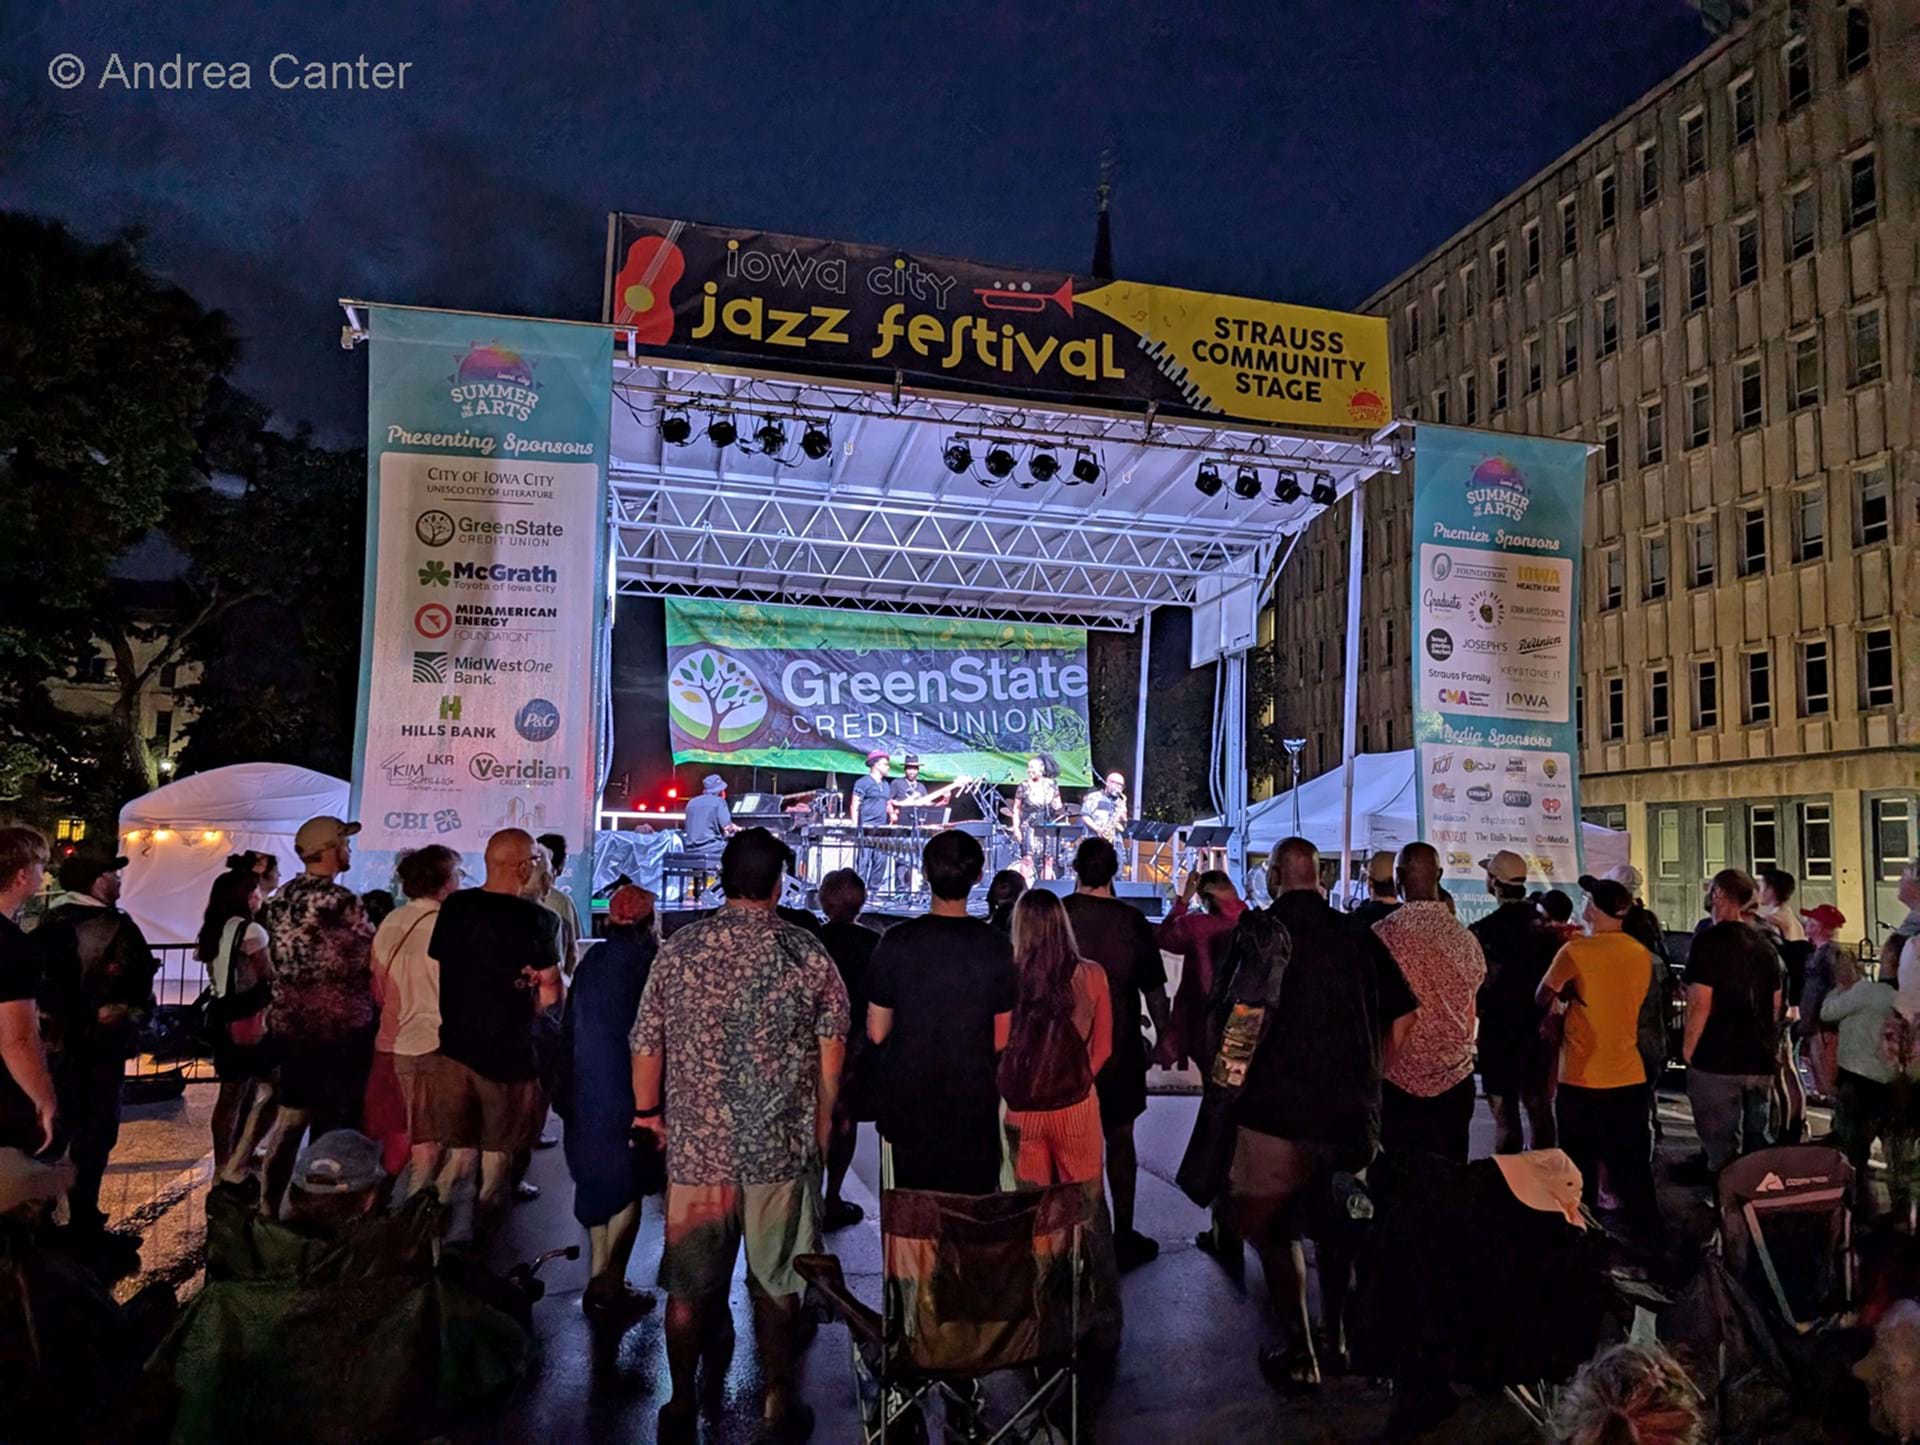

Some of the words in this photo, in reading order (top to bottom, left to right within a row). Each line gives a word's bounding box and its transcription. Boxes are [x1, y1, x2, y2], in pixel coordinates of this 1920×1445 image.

[726, 240, 847, 294] iowa
[867, 259, 957, 310] city
[691, 281, 850, 347] jazz
[872, 303, 1126, 381] festival
[1215, 316, 1344, 354] STRAUSS
[1192, 340, 1366, 382] COMMUNITY
[450, 384, 539, 408] SUMMER
[1235, 372, 1323, 403] STAGE
[475, 400, 531, 421] ARTS
[387, 424, 496, 455] Presenting
[503, 432, 593, 456] Sponsors
[427, 467, 459, 482] CITY
[462, 471, 480, 483] OF
[523, 472, 554, 487] CITY
[427, 485, 465, 495] UNESCO
[466, 487, 487, 496] CITY
[488, 488, 500, 496] OF
[502, 489, 553, 499] LITERATURE
[1466, 488, 1530, 511] SUMMER
[1483, 502, 1524, 522] ARTS
[458, 516, 563, 536] GreenState
[458, 534, 504, 545] CREDIT
[509, 536, 550, 547] UNION
[1433, 522, 1491, 543] Premier
[1495, 529, 1560, 550] Sponsors
[453, 561, 557, 583] McGrath
[454, 580, 490, 592] Toyota
[492, 583, 505, 591] of
[507, 583, 532, 592] Iowa
[534, 584, 556, 594] City
[456, 604, 557, 618] MIDAMERICAN
[455, 615, 509, 627] ENERGY
[1462, 639, 1508, 652] JOSEPH'S
[455, 657, 552, 673] MidWestOne
[1501, 666, 1549, 678] KEYSTONE
[781, 656, 1088, 707] GreenState
[1428, 668, 1460, 680] Strauss
[1461, 672, 1491, 684] Family
[1438, 688, 1468, 705] CMA
[1506, 692, 1549, 708] IOWA
[524, 712, 554, 728] P&G
[792, 711, 923, 740] CREDIT
[938, 707, 1055, 736] UNION
[401, 724, 446, 737] HILLS
[450, 725, 496, 739] BANK
[1488, 728, 1552, 747] Sponsors
[427, 753, 454, 766] LKR
[475, 758, 570, 779] Veridian
[393, 763, 424, 777] KIM
[384, 811, 429, 830] CBI
